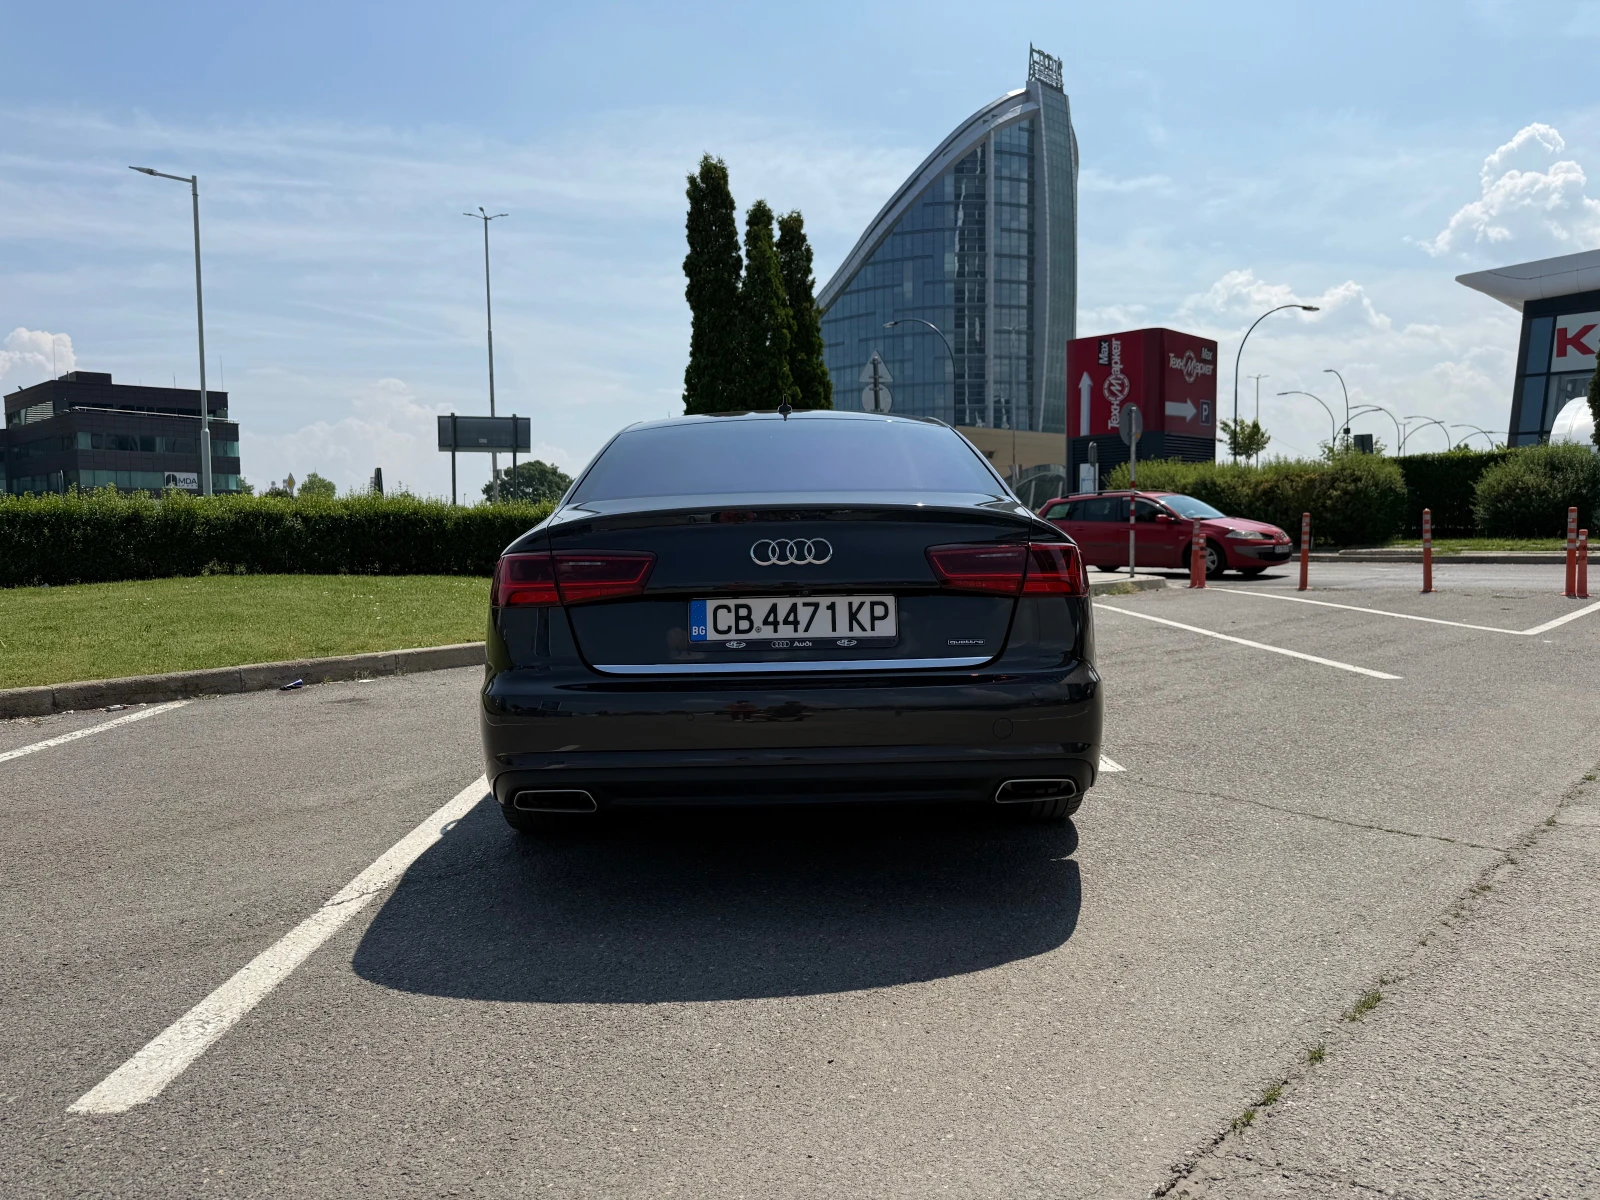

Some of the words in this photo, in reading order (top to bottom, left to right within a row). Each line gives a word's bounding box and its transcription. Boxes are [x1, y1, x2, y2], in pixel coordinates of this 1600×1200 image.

[1098, 341, 1109, 364] Max
[1201, 347, 1213, 361] Max
[1202, 404, 1209, 421] P
[692, 625, 706, 636] BG
